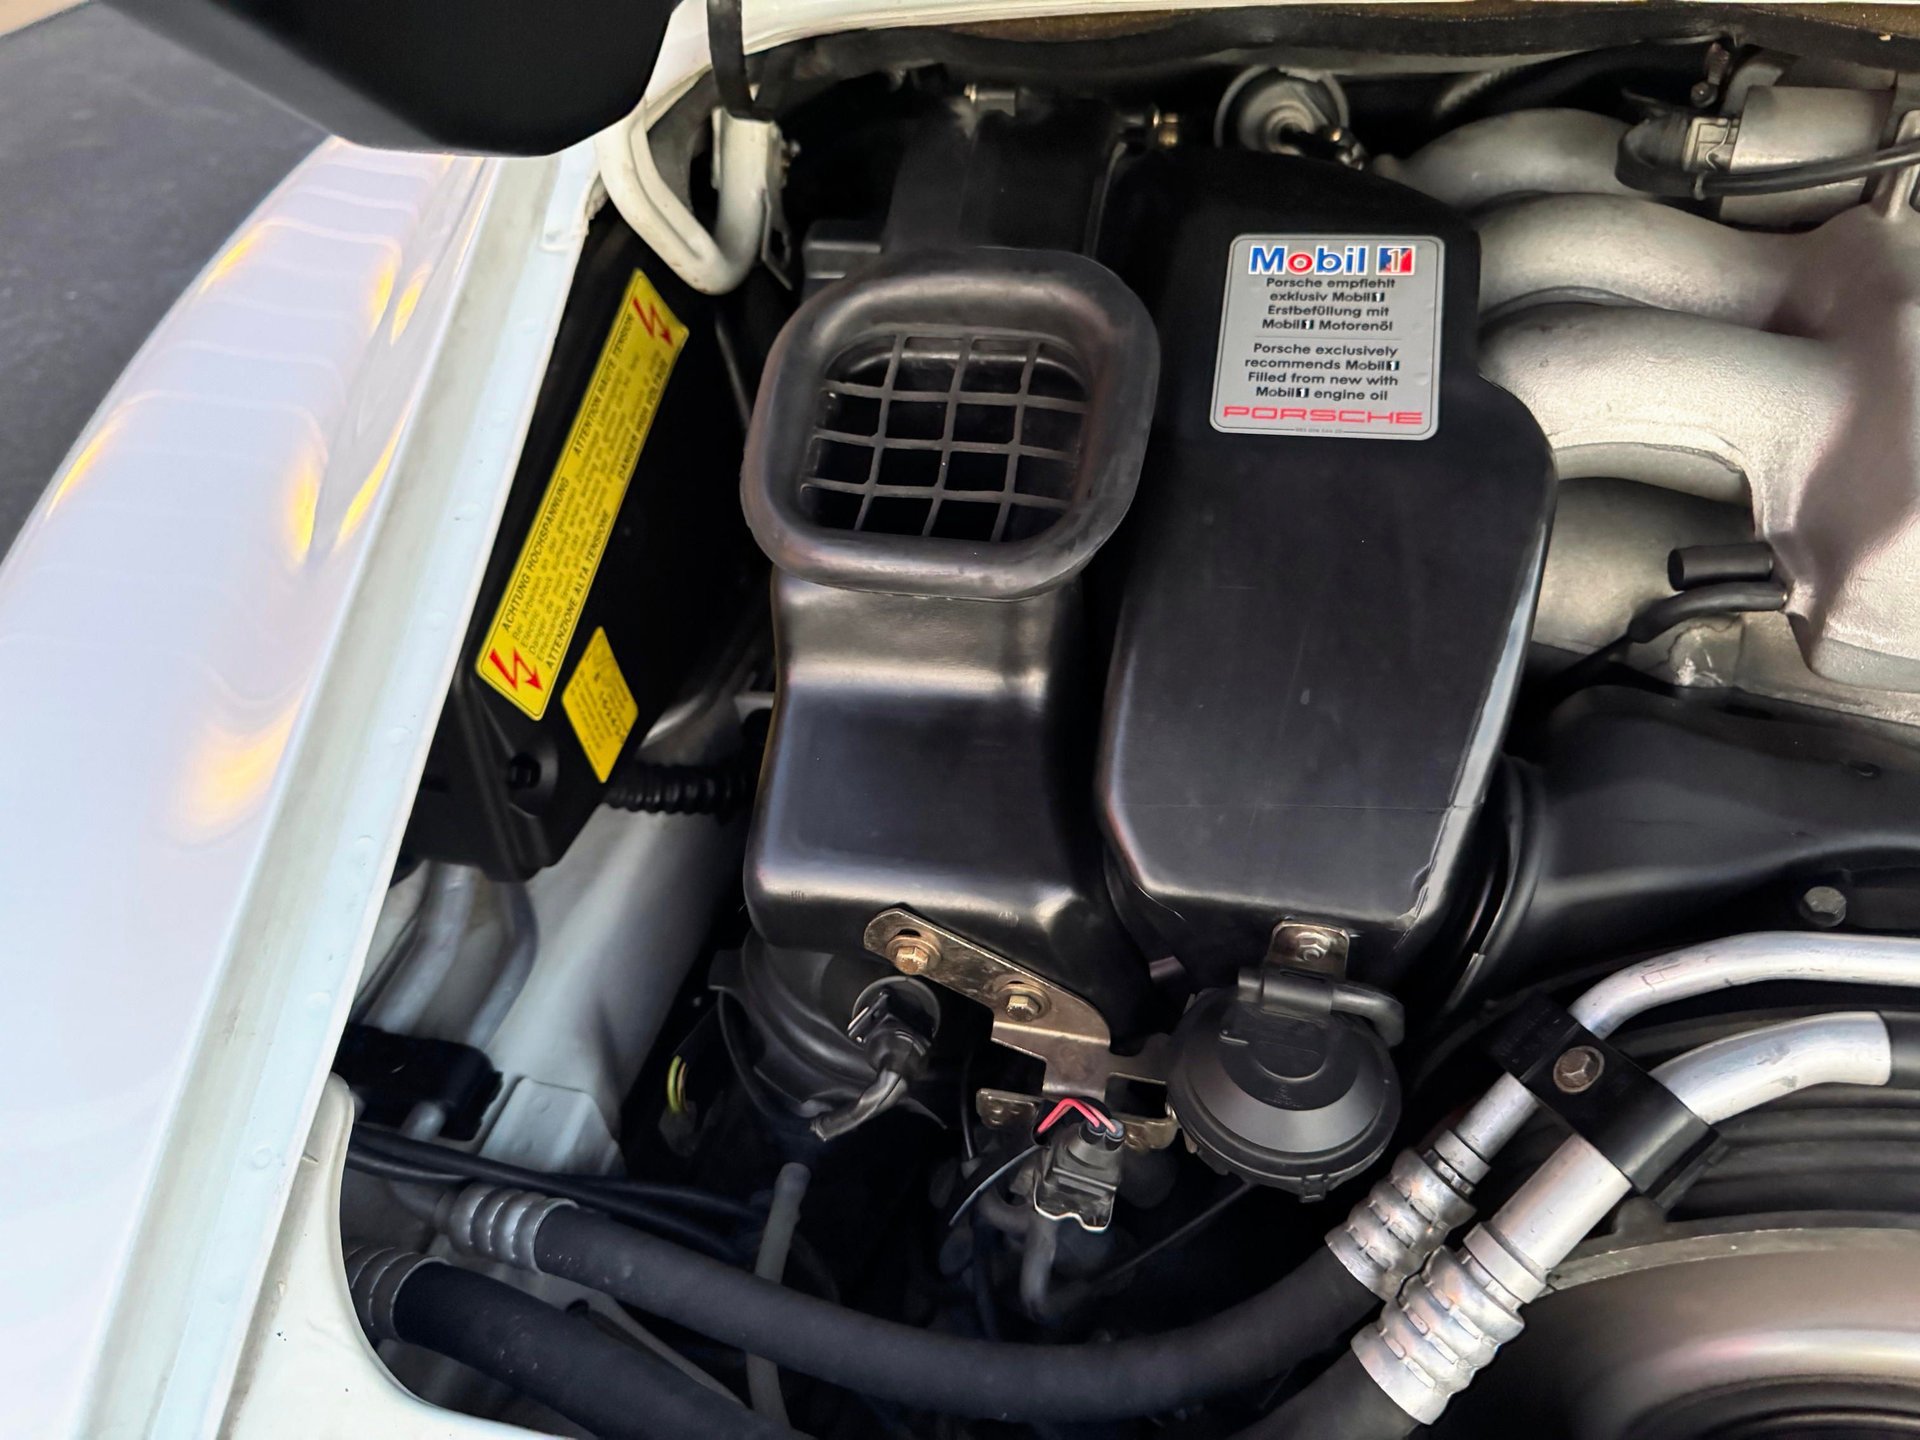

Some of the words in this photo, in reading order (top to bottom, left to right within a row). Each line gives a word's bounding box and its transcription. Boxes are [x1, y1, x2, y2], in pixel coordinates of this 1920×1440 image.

[1249, 245, 1368, 275] Mobil
[1267, 279, 1322, 288] Porsche
[1328, 279, 1395, 289] empfiehlt
[1270, 293, 1327, 302] exklusiv
[1268, 306, 1361, 318] Erstbefüllung
[1367, 307, 1389, 316] mit
[1319, 321, 1392, 331] Motorenöl
[1254, 344, 1311, 354] Porsche
[1316, 345, 1398, 356] exclusively
[1245, 358, 1340, 368] recommends
[1248, 373, 1285, 383] Filled
[1291, 374, 1325, 384] from
[1330, 376, 1361, 385] new
[1367, 376, 1398, 385] with
[1314, 390, 1364, 401] engine
[1370, 390, 1387, 400] oil
[1224, 406, 1422, 424] PORSCHE
[574, 396, 601, 456] ATTENTION
[503, 574, 530, 631] ACHTUNG
[528, 478, 568, 571] HOCHSPANNUNG
[546, 598, 577, 668] ATTENZIONE
[574, 566, 589, 595] ALTA
